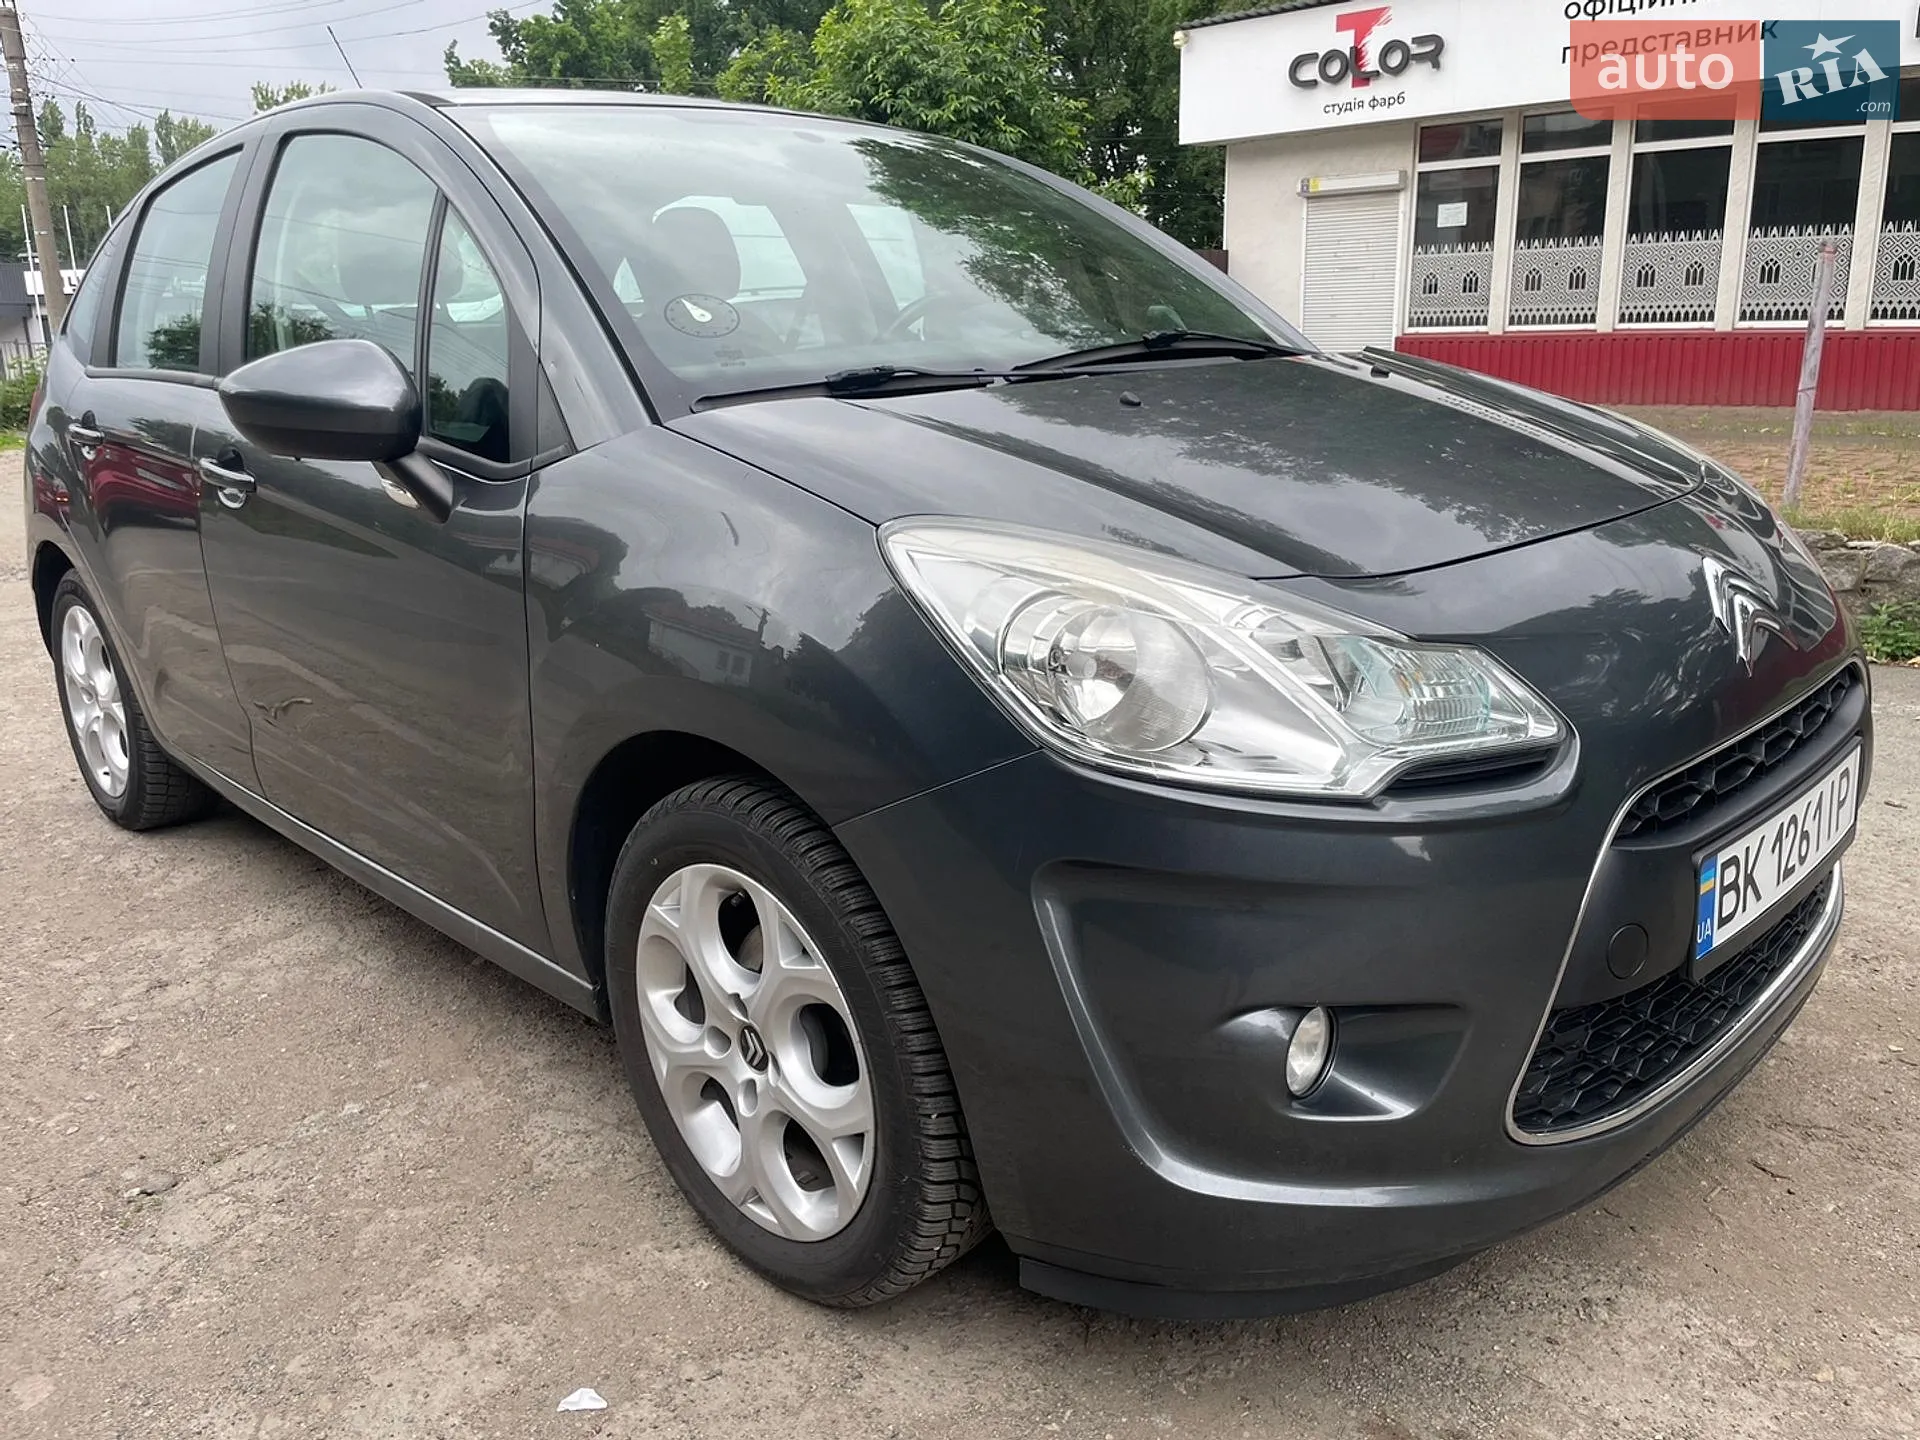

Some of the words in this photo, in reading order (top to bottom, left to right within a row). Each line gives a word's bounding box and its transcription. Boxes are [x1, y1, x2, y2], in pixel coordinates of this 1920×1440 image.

[1288, 34, 1445, 87] COLOR
[1561, 20, 1779, 67] представник
[1323, 97, 1365, 115] студія
[1368, 91, 1406, 110] фарб
[1717, 834, 1766, 930] BK
[1771, 789, 1825, 888] 1261
[1827, 767, 1852, 841] IP
[1696, 918, 1712, 943] UA
